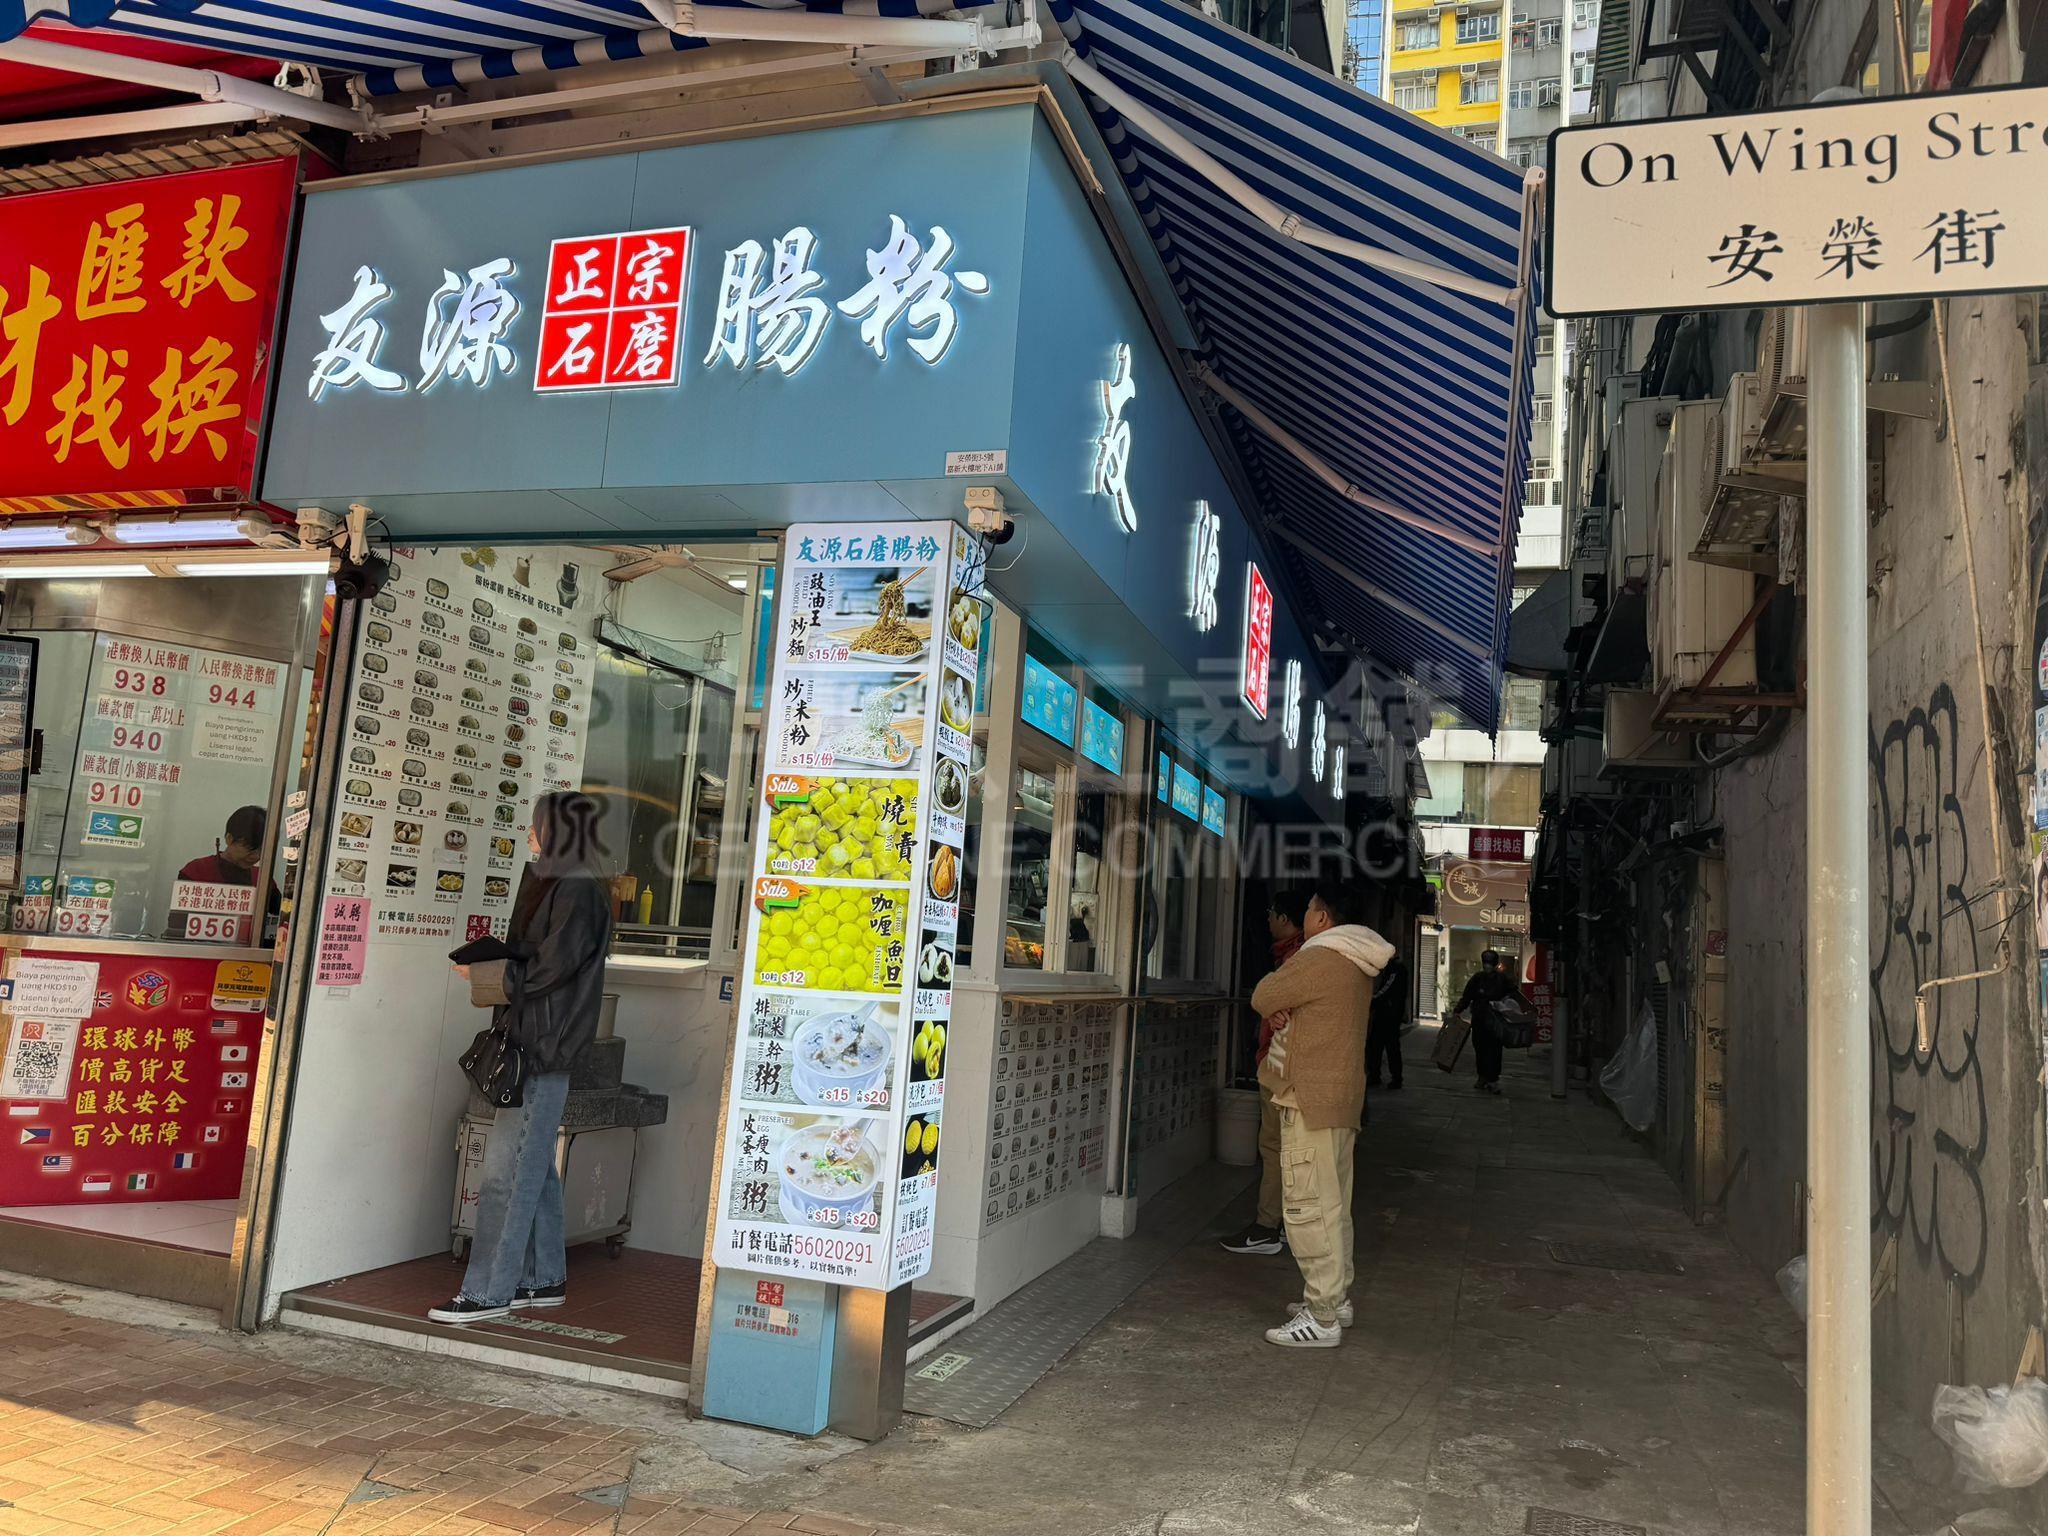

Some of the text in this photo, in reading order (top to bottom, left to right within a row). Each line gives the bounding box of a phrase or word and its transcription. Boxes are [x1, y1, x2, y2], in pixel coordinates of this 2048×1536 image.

[1580, 141, 1679, 187] On
[1709, 126, 1898, 184] Wing
[75, 194, 256, 322] 匯款
[1706, 208, 2006, 289] 安榮街
[557, 239, 676, 302] 正宗
[703, 215, 991, 377] 腸粉
[308, 258, 521, 400] 友源
[547, 311, 670, 380] 石磨
[46, 335, 241, 470] 找換
[796, 535, 941, 563] 友源石磨腸粉
[808, 572, 827, 627] 豉油王
[787, 617, 808, 658] 炒麵
[106, 641, 190, 672] 港幣換人民幣價
[808, 648, 849, 661] $15/份
[114, 669, 166, 696] 938
[198, 657, 278, 685] 人民幣換港幣價
[209, 684, 256, 709] 944
[98, 697, 185, 726] 匯款價 一萬以上
[784, 678, 812, 746] 炒米粉
[113, 726, 162, 751] 940
[205, 721, 264, 735] Biaya pengiriman
[210, 732, 257, 743] uang HKD$10
[83, 754, 181, 785] 匯款價 小額匯款價
[235, 755, 263, 763] nyaman
[792, 753, 833, 766] $15/份
[90, 781, 142, 807] 910
[767, 777, 799, 795] Sale
[881, 795, 918, 865] 燒賣
[792, 859, 816, 871] $12
[178, 884, 252, 900] 內地收人民幣
[758, 880, 789, 898] Sale
[67, 896, 109, 911] 充值價
[178, 896, 250, 912] 香港取港幣價
[333, 903, 362, 922] 誠聘
[14, 908, 47, 930] 937
[58, 909, 109, 935] 937
[188, 917, 235, 938] 956
[15, 971, 86, 982] Biaya pengiriman
[760, 971, 804, 984] 10粒 $12
[884, 940, 903, 989] 魚旦
[21, 983, 77, 992] uang HKD$10
[8, 1004, 31, 1013] cepat
[50, 1006, 83, 1015] nyaman
[754, 998, 771, 1039] 排骨
[82, 1027, 195, 1052] 環球外幣
[80, 1058, 191, 1084] 價高貨足
[754, 1062, 783, 1096] 粥
[75, 1090, 187, 1115] 匯款安全
[825, 1087, 849, 1102] $15
[863, 1089, 887, 1105] $20
[71, 1122, 181, 1147] 百分保障
[741, 1113, 757, 1155] 皮蛋
[757, 1125, 770, 1133] EGG
[754, 1134, 770, 1175] 瘦肉
[741, 1180, 769, 1214] 粥
[814, 1209, 838, 1223] $15
[853, 1212, 877, 1227] $20
